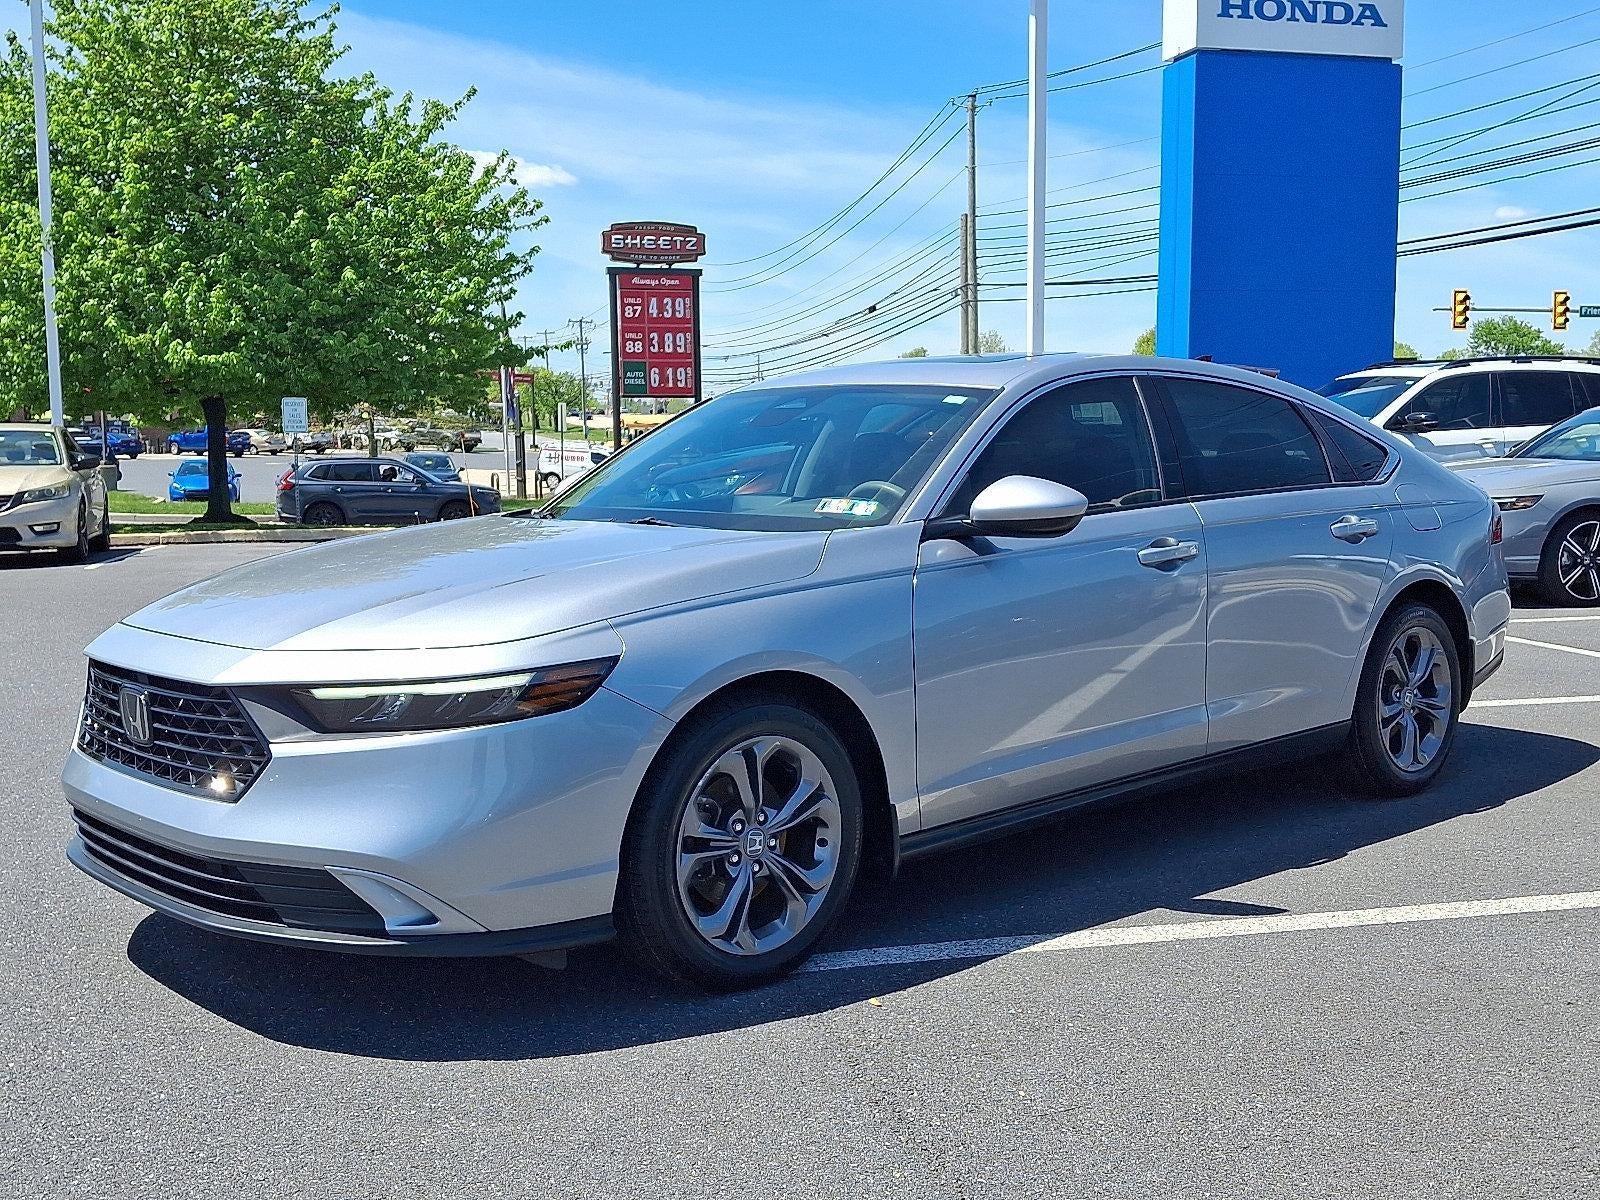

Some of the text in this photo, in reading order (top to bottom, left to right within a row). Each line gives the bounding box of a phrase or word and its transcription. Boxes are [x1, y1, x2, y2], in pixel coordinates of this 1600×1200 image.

[1216, 0, 1388, 27] HONDA
[611, 235, 698, 250] SHEETZ
[631, 277, 680, 287] Always Open
[624, 306, 642, 318] 87
[648, 297, 684, 318] 4.39
[625, 341, 643, 353] 88
[649, 332, 685, 352] 3.89
[650, 367, 686, 387] 6.19
